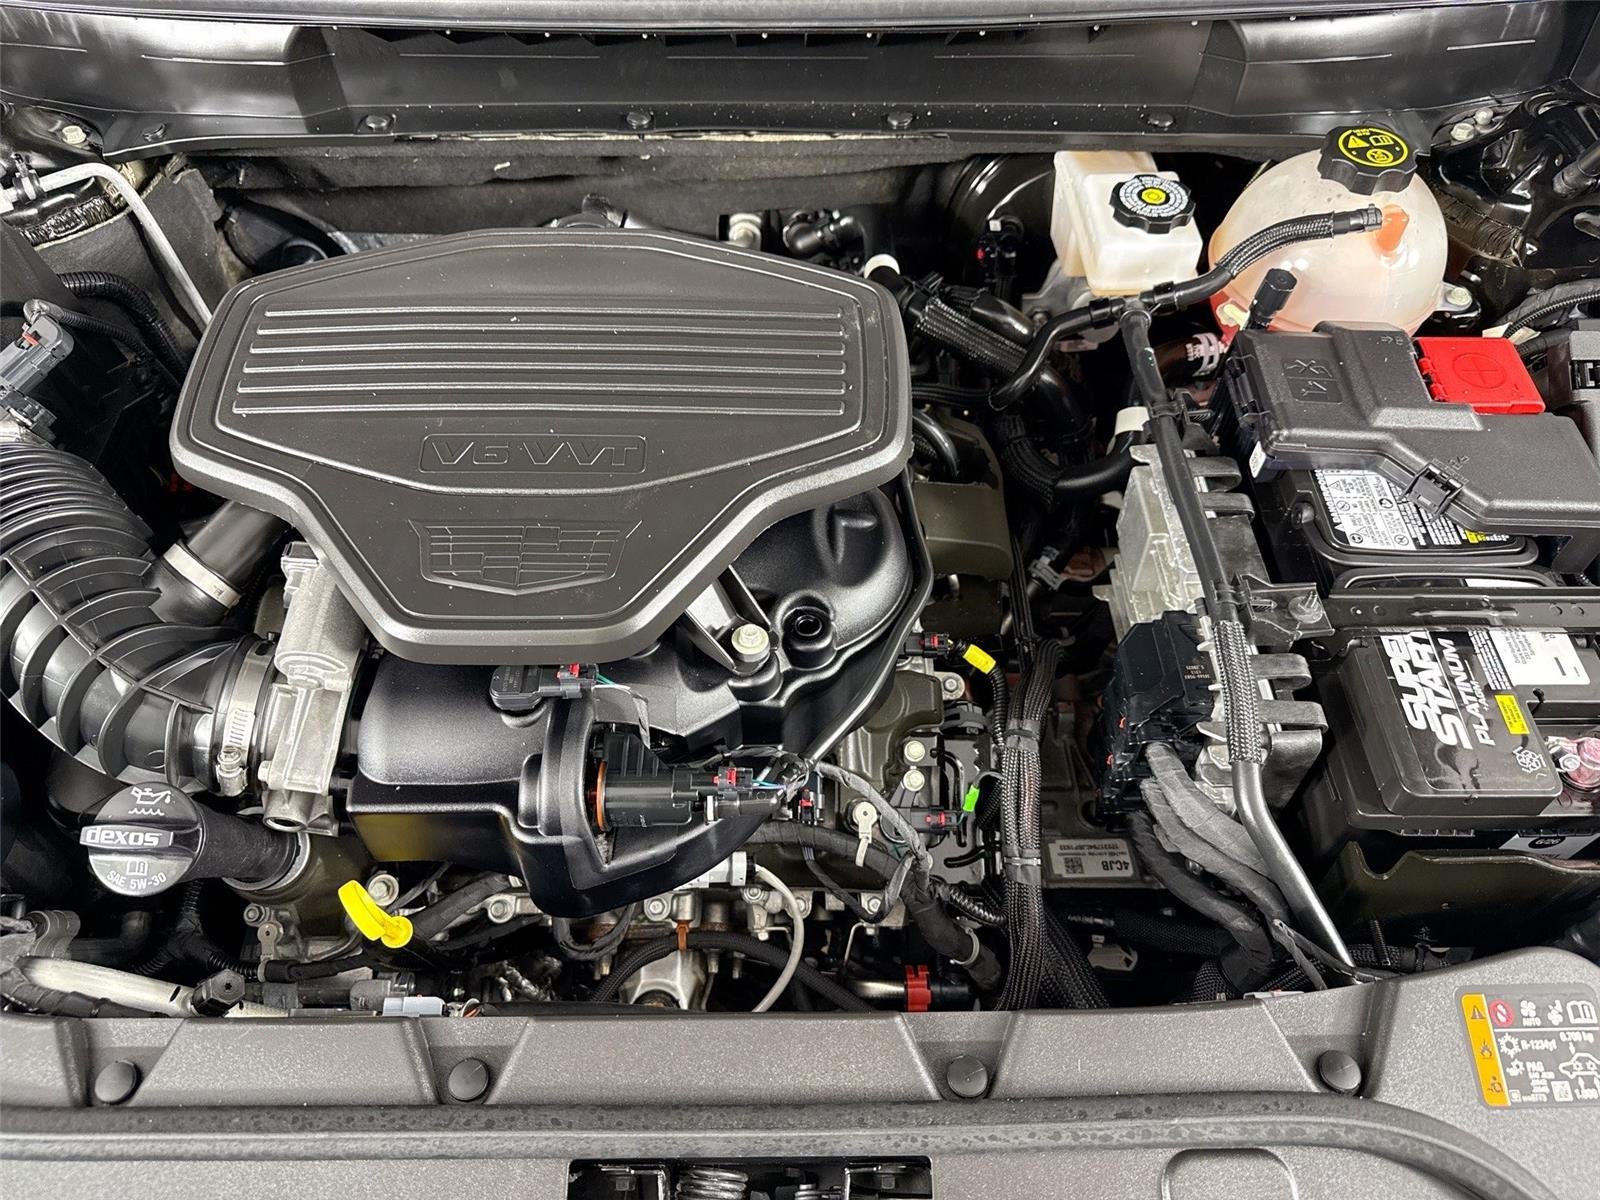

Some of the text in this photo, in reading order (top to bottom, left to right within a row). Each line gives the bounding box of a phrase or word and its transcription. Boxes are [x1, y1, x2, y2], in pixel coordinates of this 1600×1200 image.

[432, 441, 638, 466] V6 VVT
[1380, 634, 1429, 730] SUPE
[1437, 637, 1496, 746] PLATINUM
[85, 826, 163, 847] dexos
[1101, 860, 1130, 871] 4CJB
[106, 870, 167, 890] SAE 5W-30
